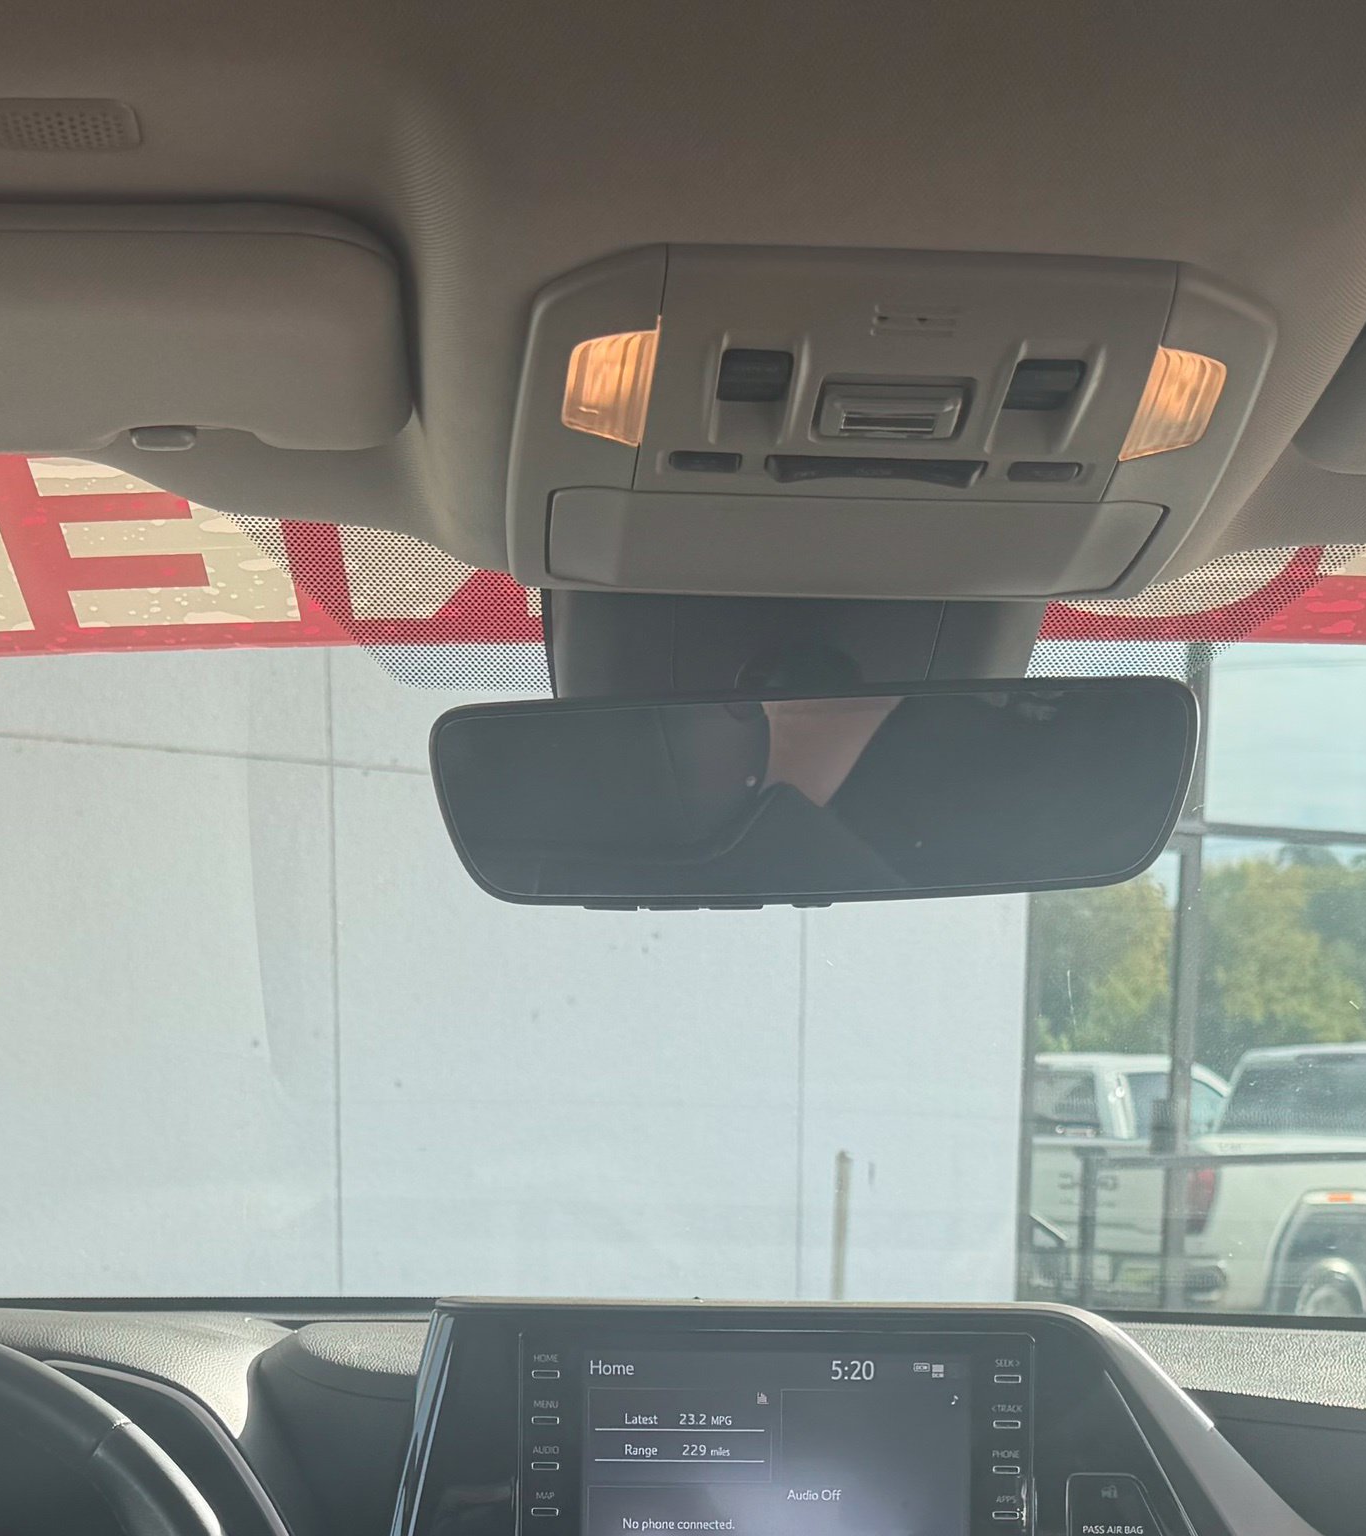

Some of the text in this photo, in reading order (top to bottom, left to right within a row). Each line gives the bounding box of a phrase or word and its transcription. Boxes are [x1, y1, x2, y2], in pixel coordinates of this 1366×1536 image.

[533, 1353, 559, 1364] HOME
[589, 1360, 635, 1377] Home
[830, 1360, 876, 1381] 5:20
[533, 1399, 559, 1409] MENU
[624, 1413, 733, 1426] Latest 23.2 MPG
[532, 1445, 559, 1455] AUDIO
[624, 1443, 731, 1458] Range 229 miles
[992, 1449, 1020, 1459] PHONE
[535, 1491, 555, 1500] MAP
[786, 1489, 842, 1501] Audio Off
[622, 1517, 736, 1531] No phone connected.
[1082, 1525, 1144, 1535] PASS AIR BAG
